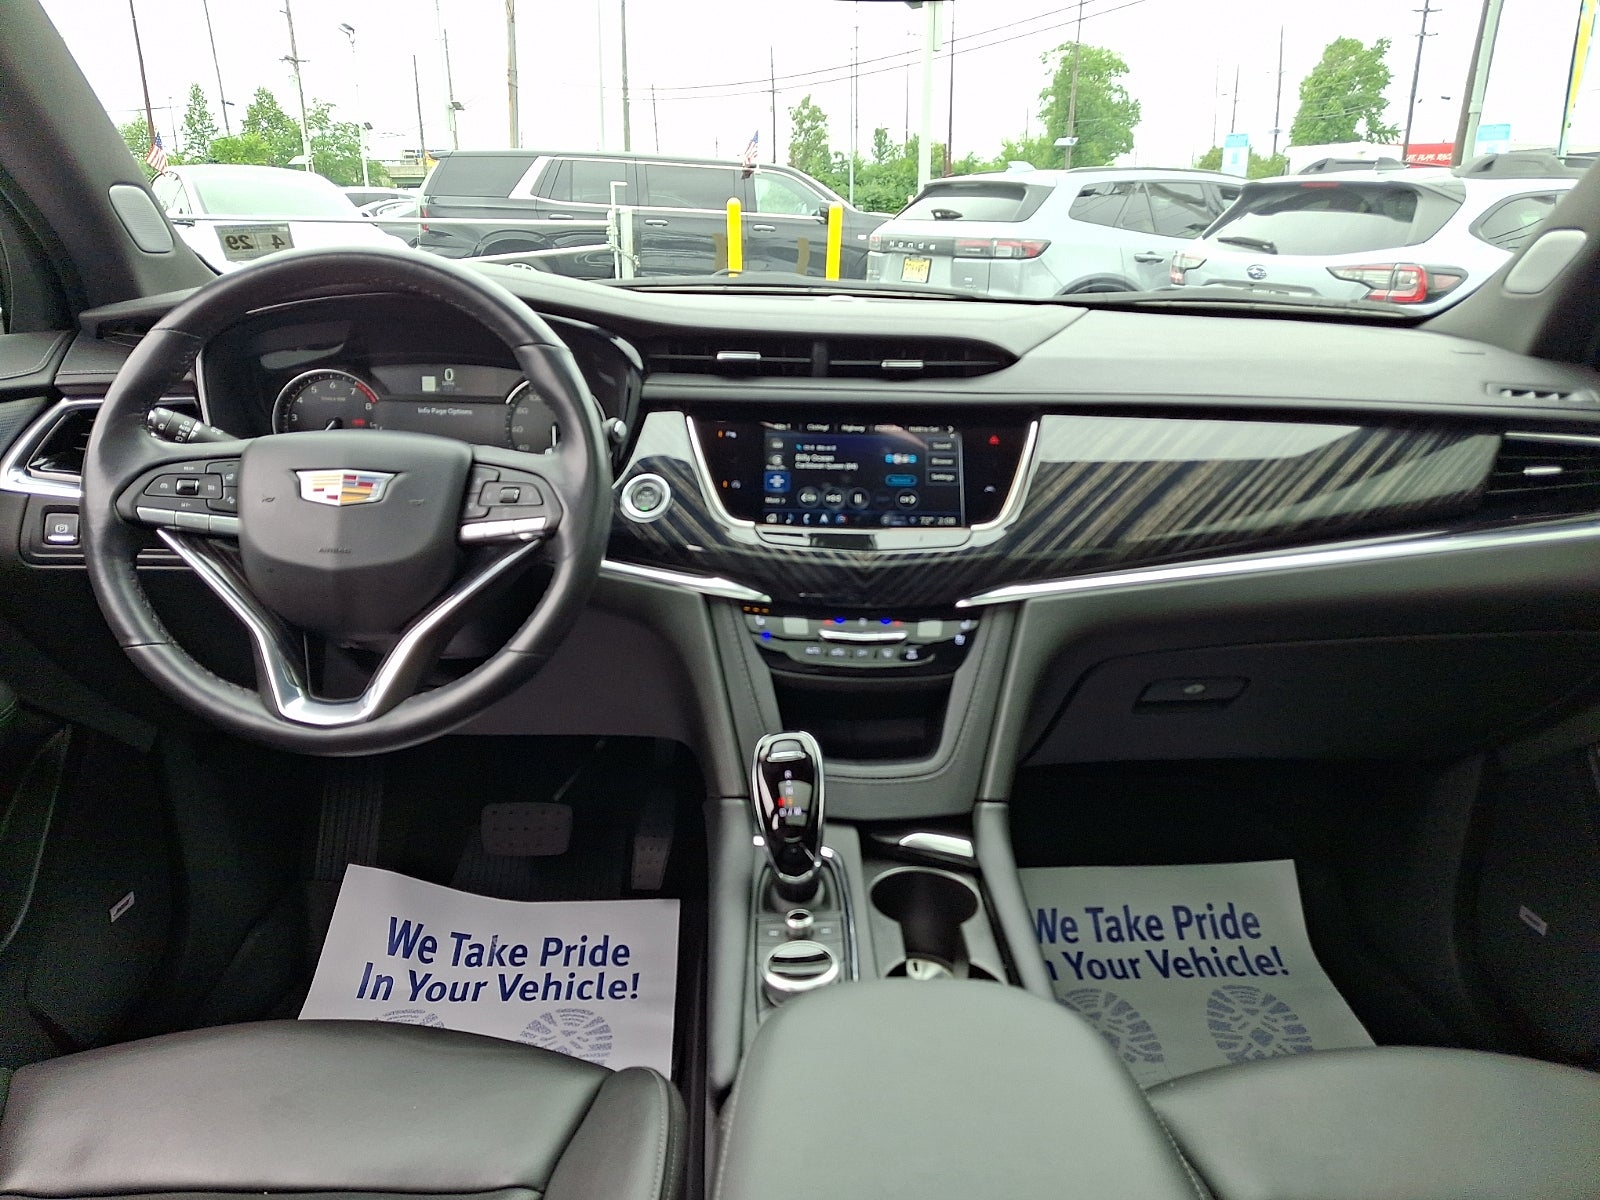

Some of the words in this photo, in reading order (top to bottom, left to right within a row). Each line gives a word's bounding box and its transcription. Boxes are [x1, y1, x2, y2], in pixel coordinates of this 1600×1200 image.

[889, 240, 936, 250] Honda
[444, 368, 454, 381] 0
[1035, 907, 1079, 944] We
[1084, 905, 1164, 944] Take
[1171, 902, 1261, 940] Pride
[386, 916, 438, 964] We
[450, 931, 528, 968] Take
[540, 935, 631, 967] Pride
[356, 962, 395, 1001] In
[407, 969, 488, 1002] Your
[498, 971, 640, 1002] Vehicle!
[1061, 950, 1140, 981] Your
[1145, 946, 1288, 979] Vehicle!
